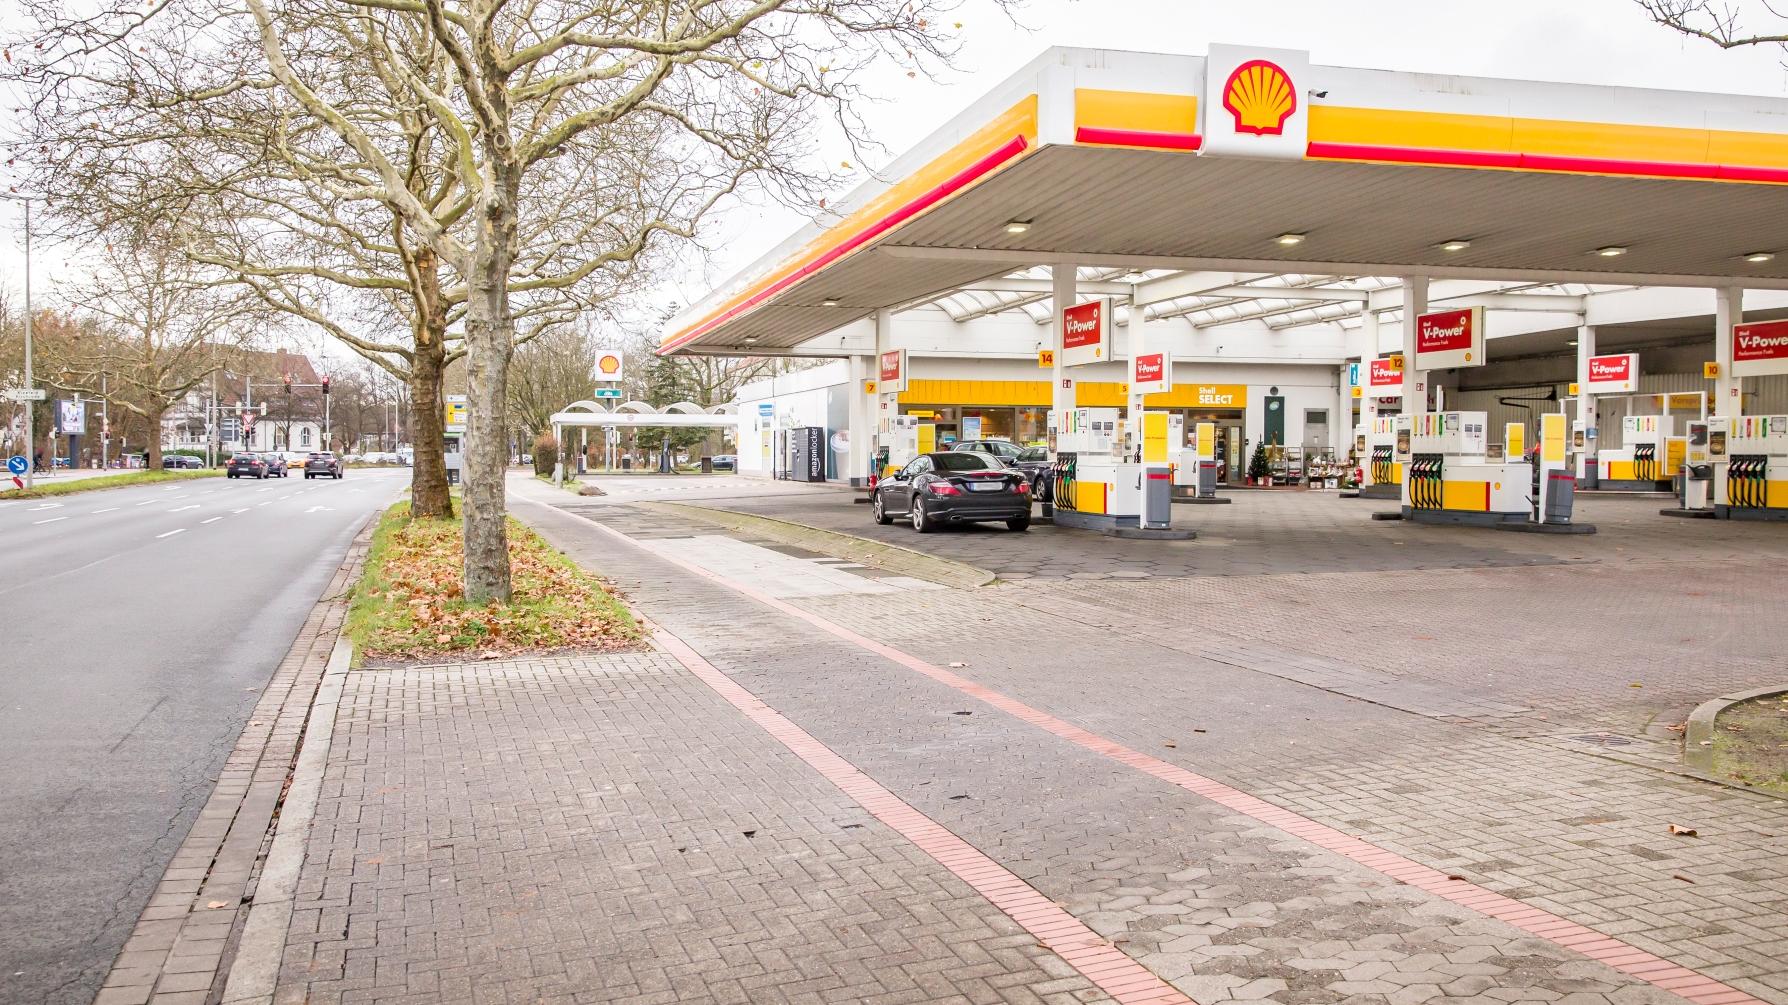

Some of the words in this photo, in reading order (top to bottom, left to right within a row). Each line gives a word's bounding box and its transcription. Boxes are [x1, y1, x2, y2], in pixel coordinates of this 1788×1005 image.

[1066, 320, 1097, 335] V-Power
[1423, 326, 1465, 340] V-Power
[1041, 354, 1053, 364] 14
[1393, 358, 1403, 368] 12
[1592, 365, 1626, 375] V-Power
[1708, 366, 1718, 375] 10
[1199, 386, 1215, 395] Shell
[1199, 395, 1233, 405] SELECT
